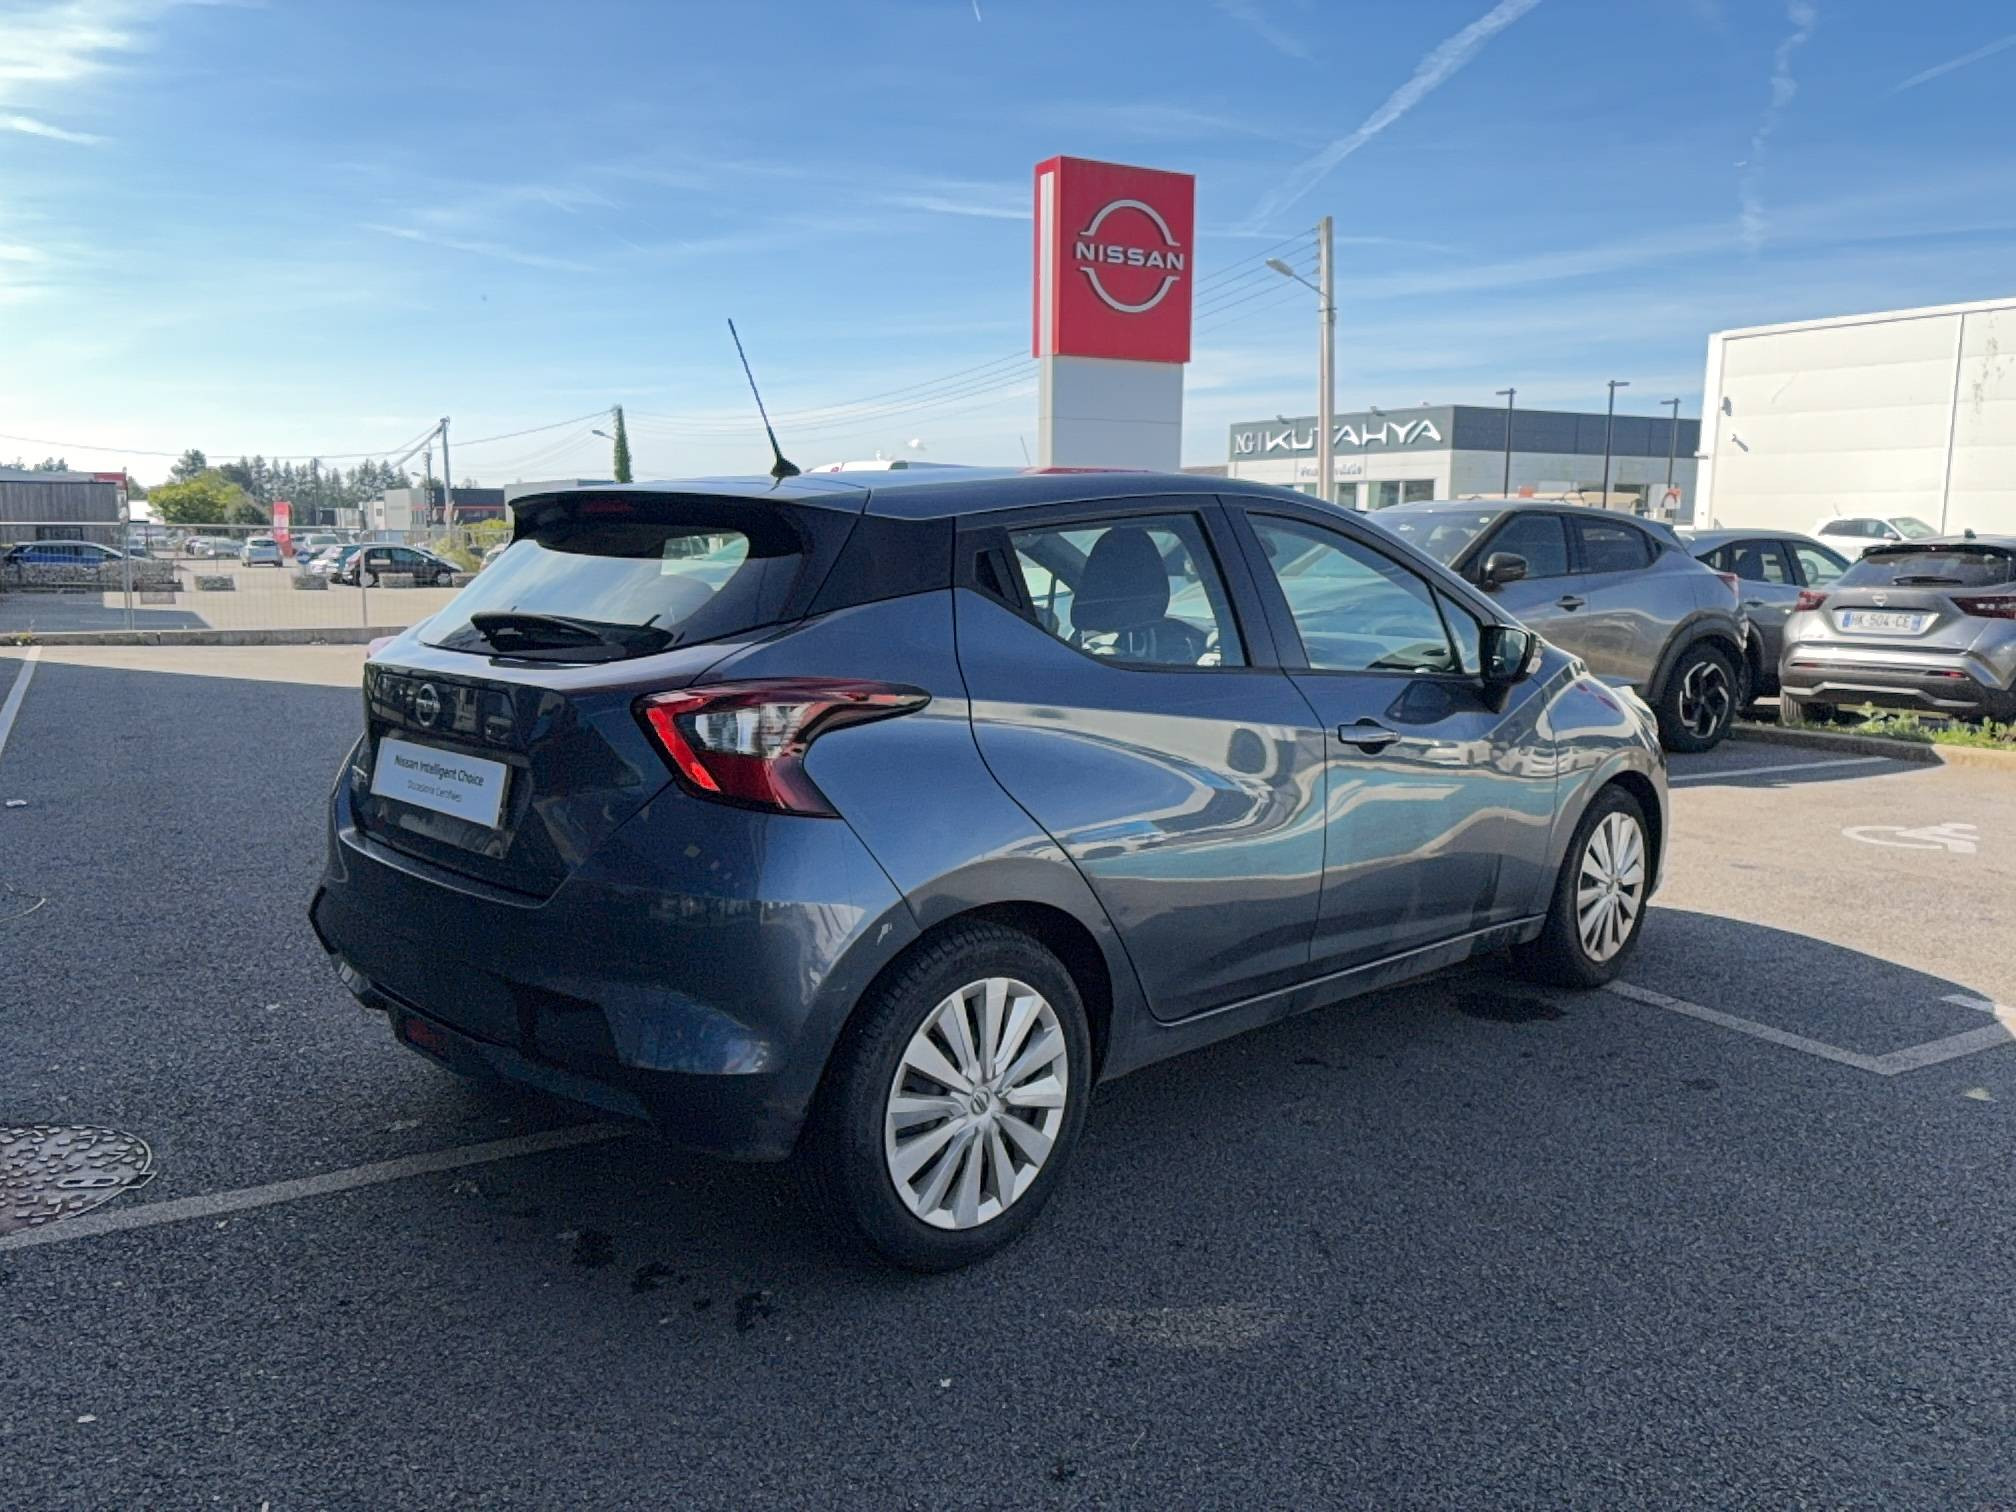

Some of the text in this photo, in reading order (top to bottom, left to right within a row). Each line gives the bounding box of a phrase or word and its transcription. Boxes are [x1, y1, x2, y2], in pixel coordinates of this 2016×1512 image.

[1075, 241, 1184, 271] NISSAN
[394, 754, 484, 787] Nissan Intelligent Choice
